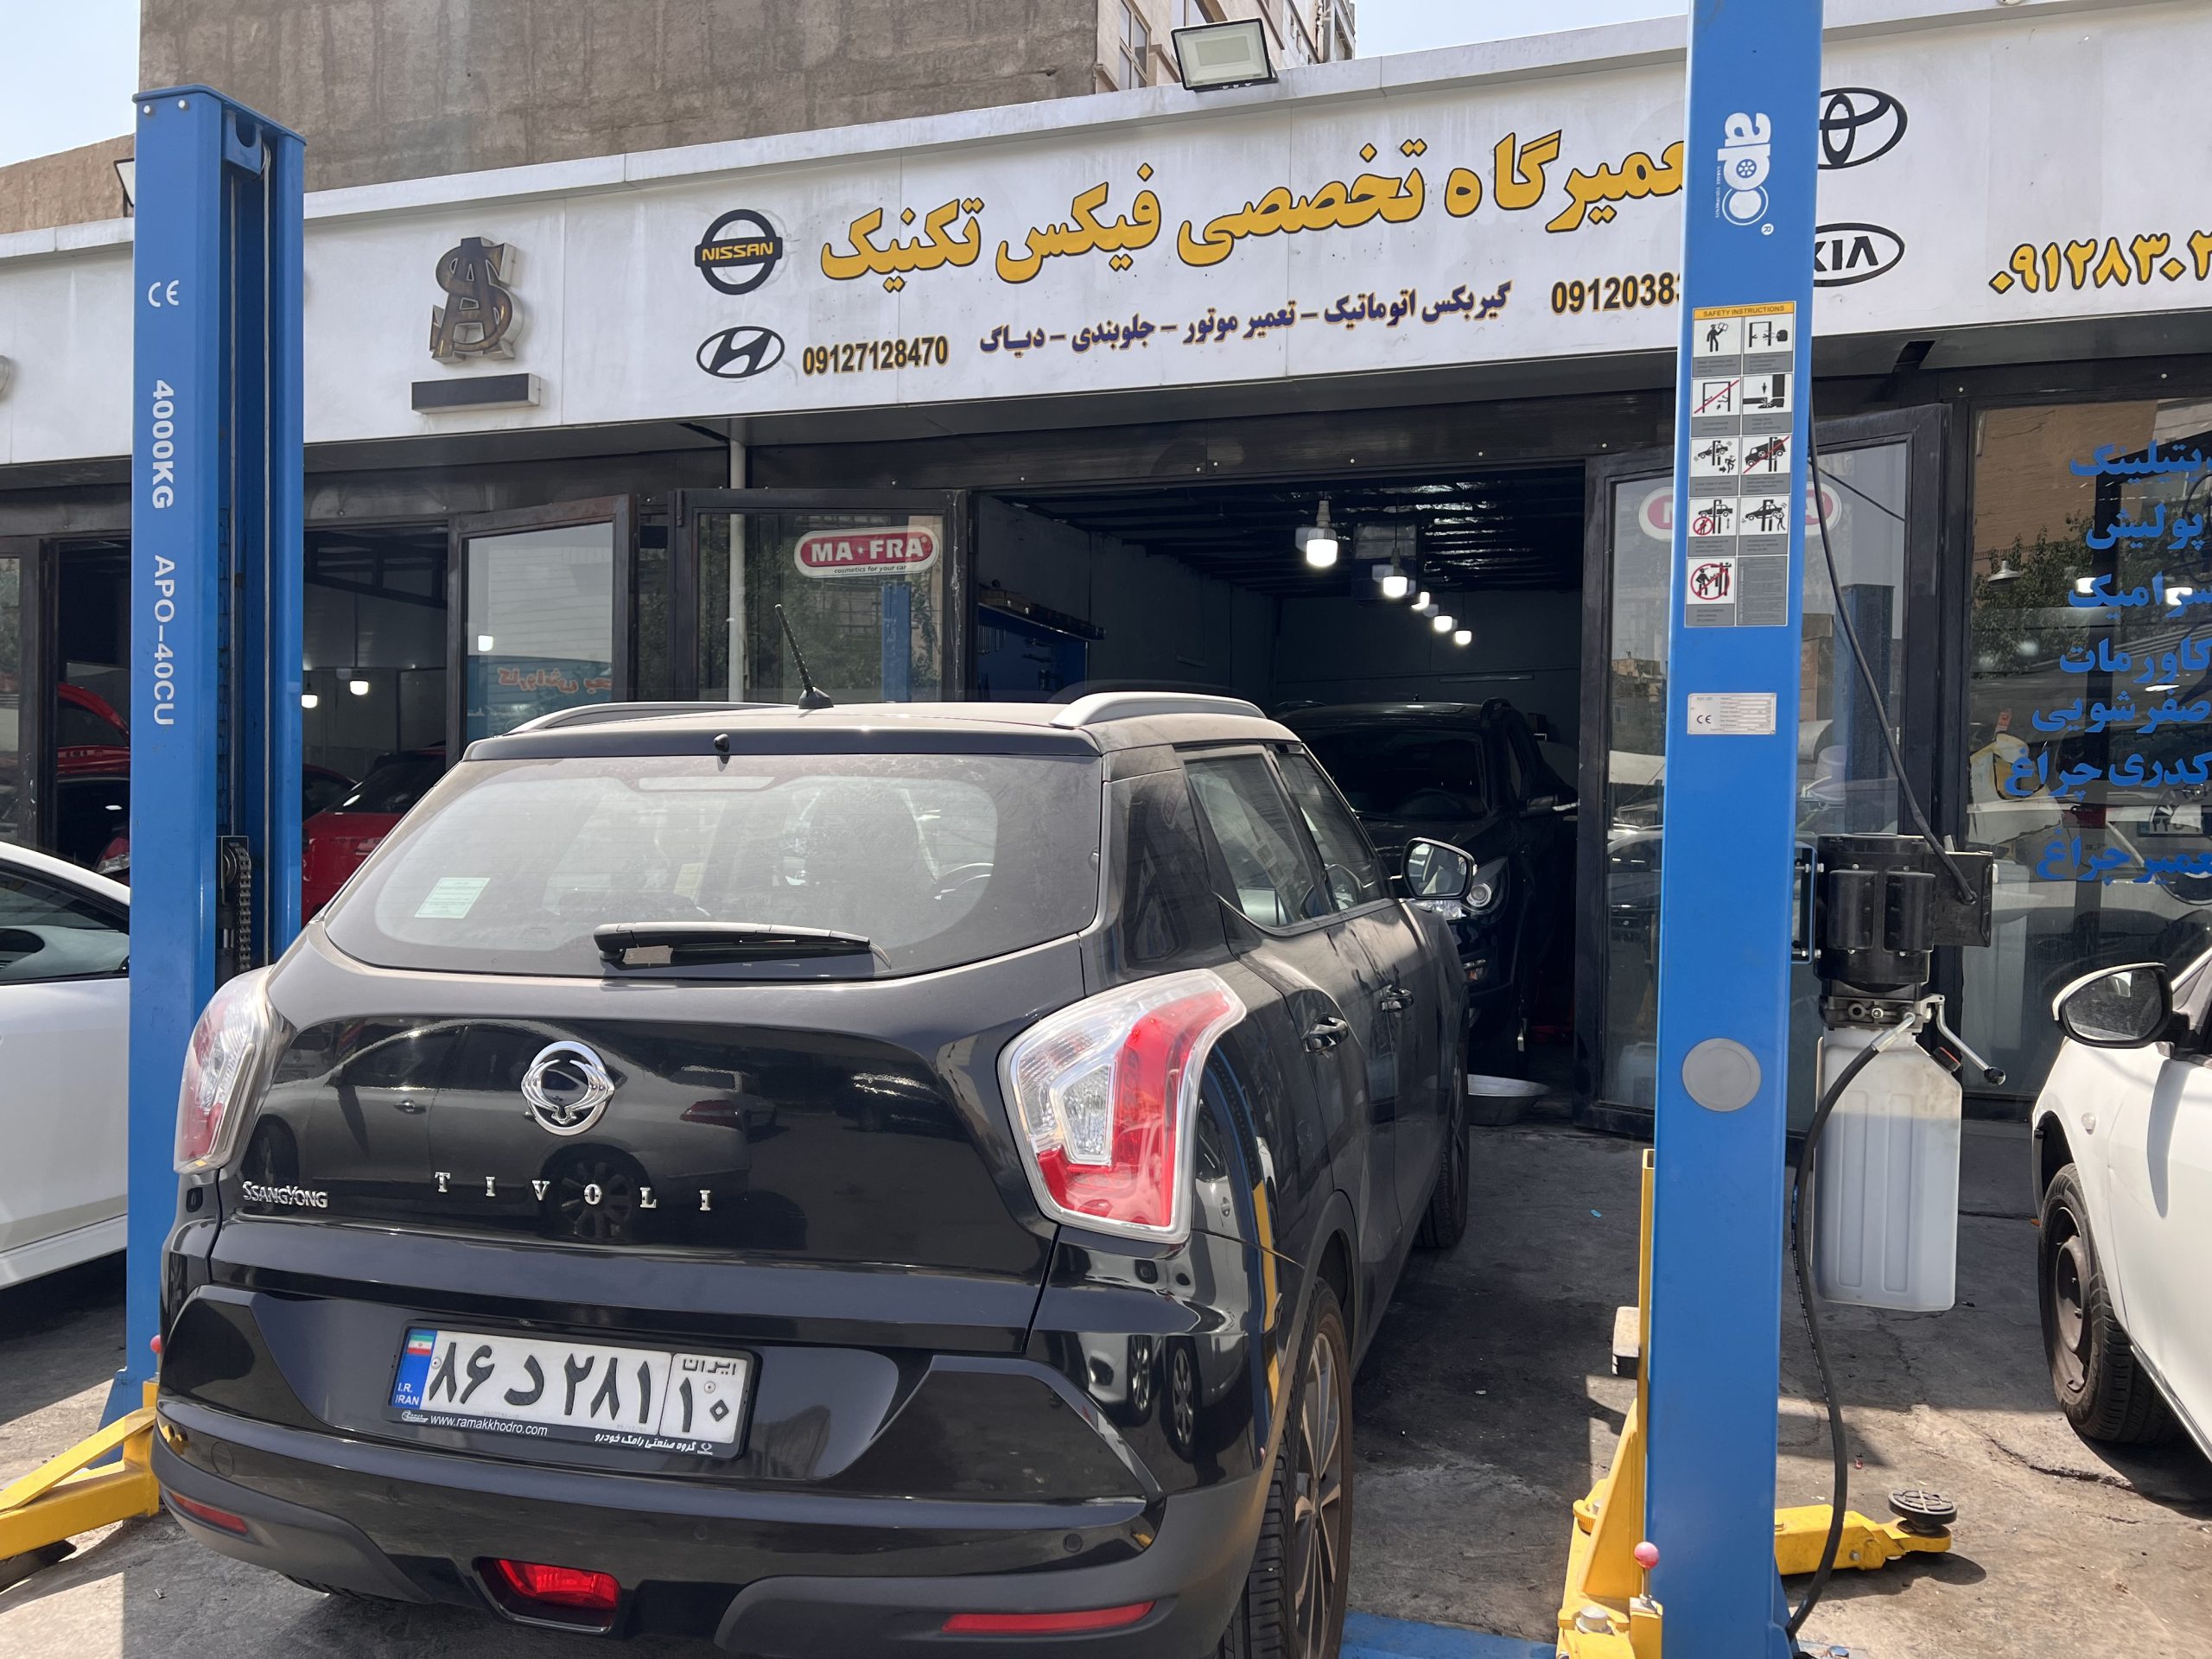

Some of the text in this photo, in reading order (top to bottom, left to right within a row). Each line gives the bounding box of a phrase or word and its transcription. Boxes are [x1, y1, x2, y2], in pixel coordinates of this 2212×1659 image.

[821, 128, 1684, 292] عمیرگاه تخصصی فیکس تکنیک
[701, 241, 774, 263] NISSAN
[1325, 289, 1416, 331] اتوماتیک
[1421, 279, 1513, 324] گیربکس
[1551, 272, 1680, 315] 0912038
[1732, 305, 1784, 315] INSTRUCTIONS
[979, 324, 1046, 358] دیاگ
[1071, 312, 1156, 354] جلوبندی
[1183, 308, 1238, 345] موتور
[1243, 300, 1296, 340] تعمیر
[803, 334, 949, 377] 09127128470
[152, 379, 175, 509] 4000KG
[2069, 439, 2212, 484] یتیلینگ
[2086, 503, 2205, 551] پولیش
[2068, 570, 2212, 620] سرامیک
[2005, 747, 2103, 802] چراغ
[2037, 829, 2212, 887] عمیر چراغ
[434, 1171, 712, 1211] TIVOLI
[397, 1382, 413, 1394] I.R.
[681, 1358, 736, 1376] ایران
[395, 1393, 420, 1407] IRAN
[678, 1376, 729, 1433] ۱۰
[430, 1414, 548, 1436] www.ramakkhodro.com
[594, 1432, 697, 1452] گروه صنعتی رامک خودرو
